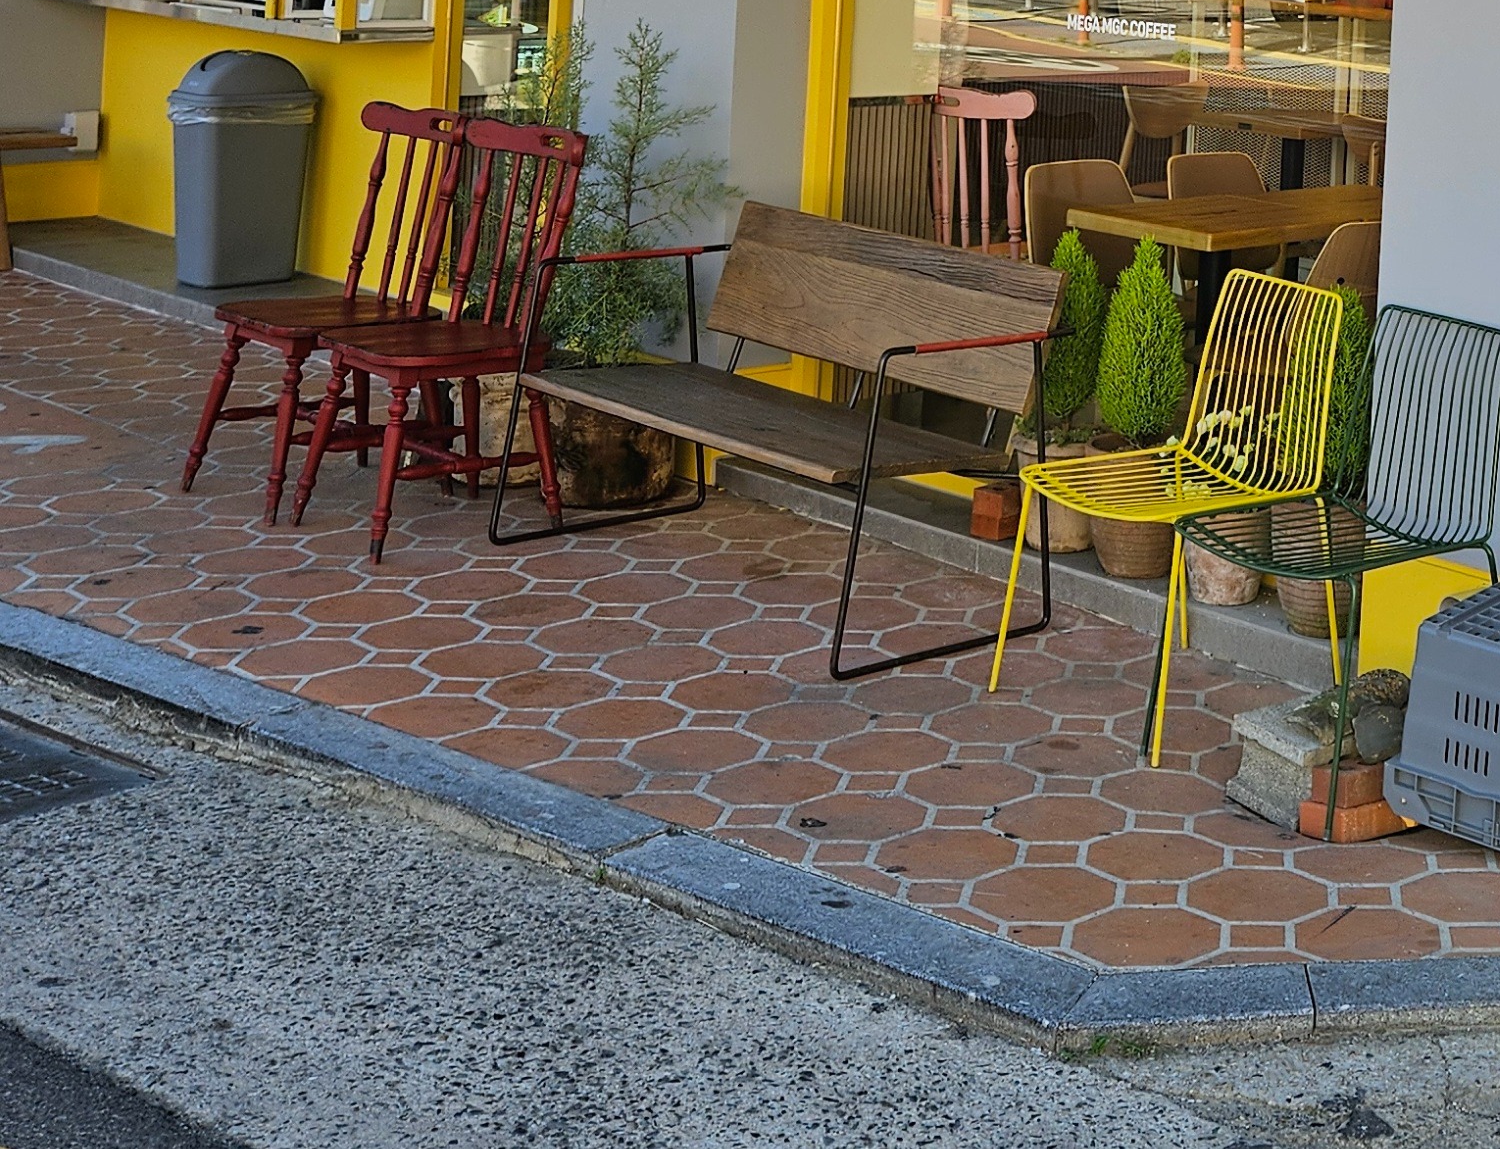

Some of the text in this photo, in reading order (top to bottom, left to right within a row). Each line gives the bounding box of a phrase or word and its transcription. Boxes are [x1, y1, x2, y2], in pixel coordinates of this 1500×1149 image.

[1067, 14, 1177, 40] MEGA MGC COFFEE
